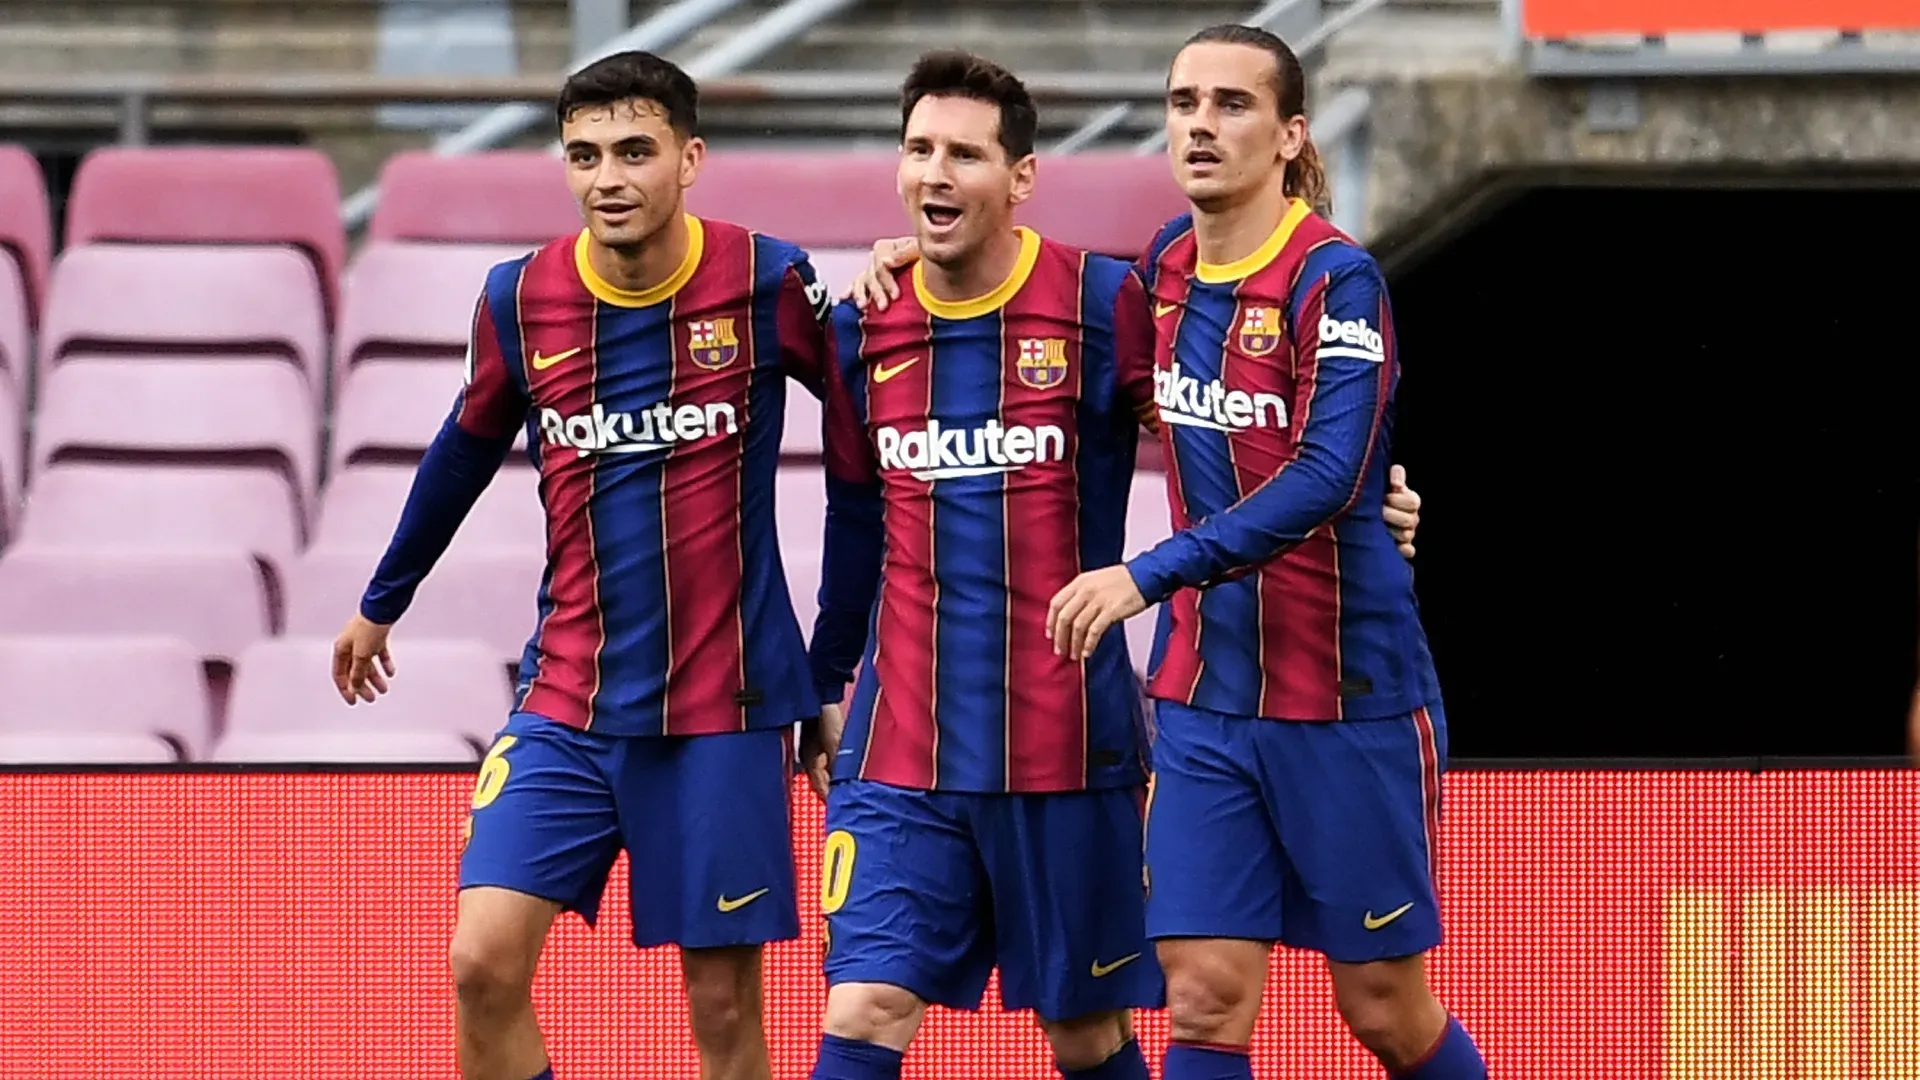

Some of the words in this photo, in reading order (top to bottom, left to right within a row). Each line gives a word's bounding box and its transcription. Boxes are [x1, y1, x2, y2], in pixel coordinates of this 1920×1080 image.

[1318, 314, 1384, 354] beko
[1153, 362, 1289, 429] akuten
[539, 401, 738, 451] Rakuten
[876, 419, 1066, 470] Rakuten
[472, 735, 518, 810] 6
[821, 830, 857, 915] 0
